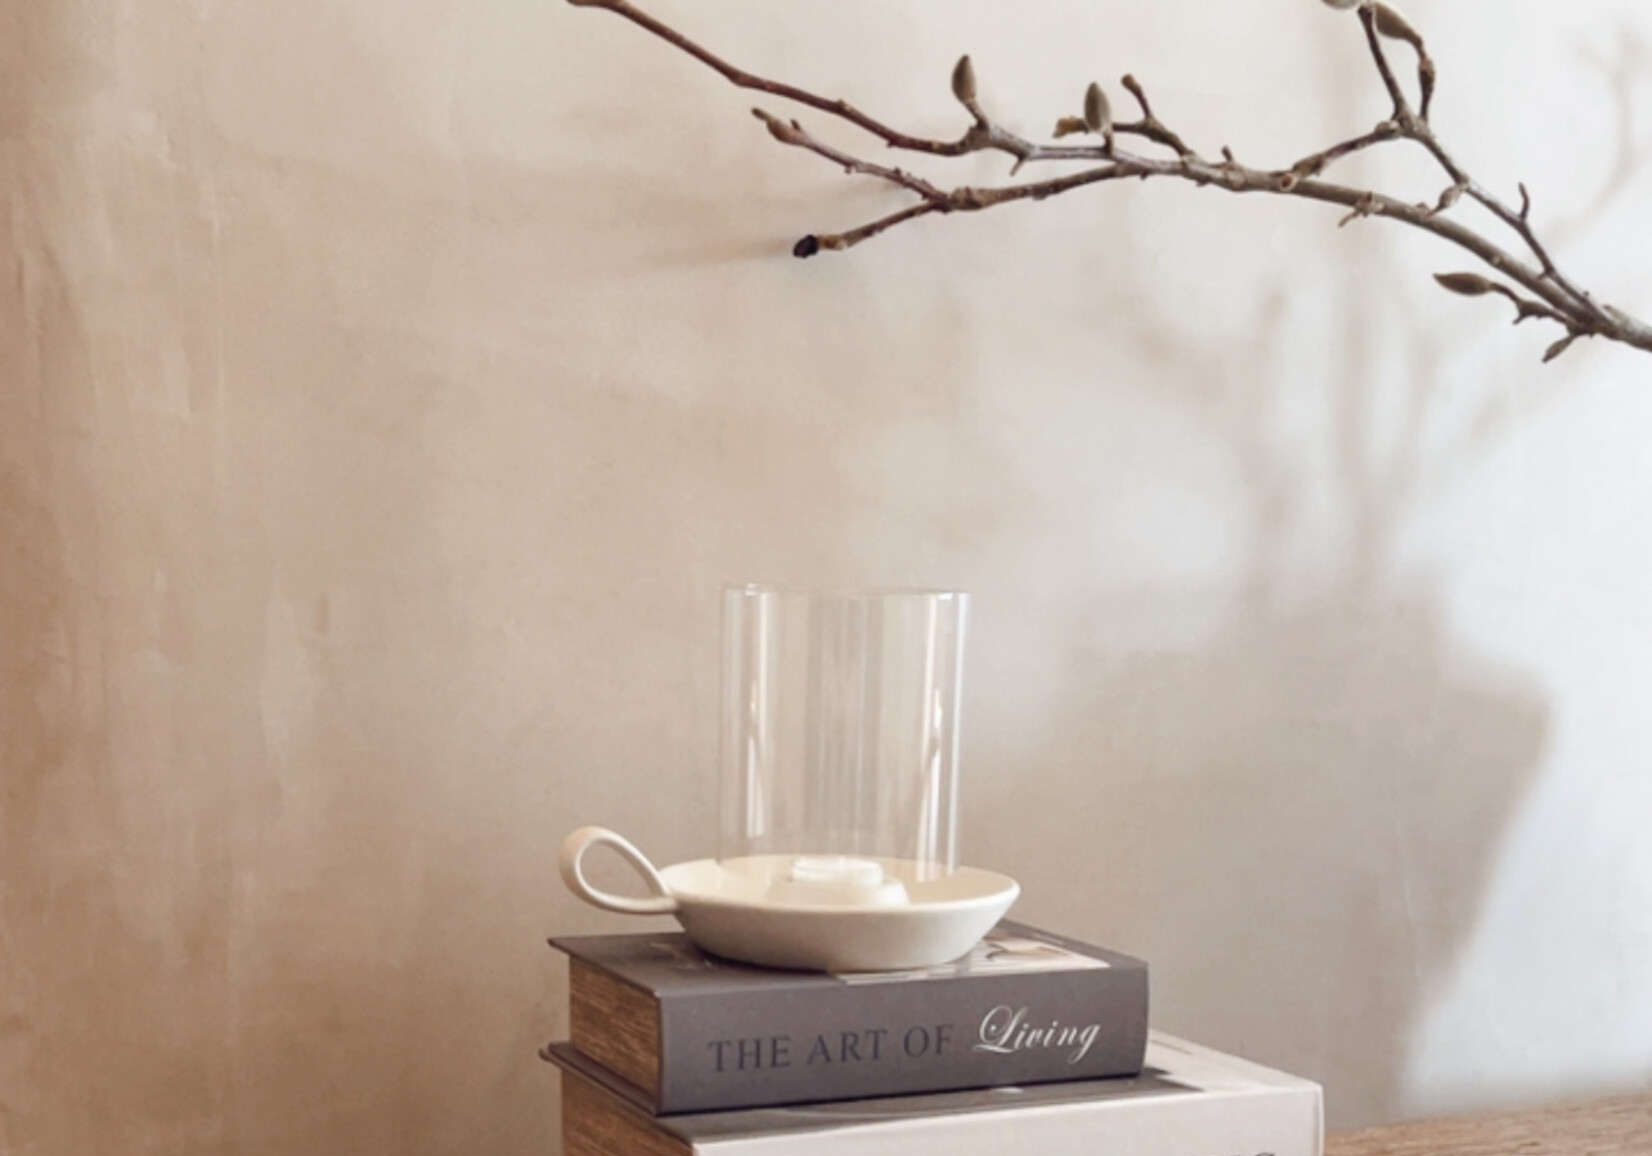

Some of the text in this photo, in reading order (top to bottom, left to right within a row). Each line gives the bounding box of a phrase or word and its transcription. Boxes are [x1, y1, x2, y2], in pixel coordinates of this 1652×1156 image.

[708, 1005, 1101, 1073] THE ART OF Living
